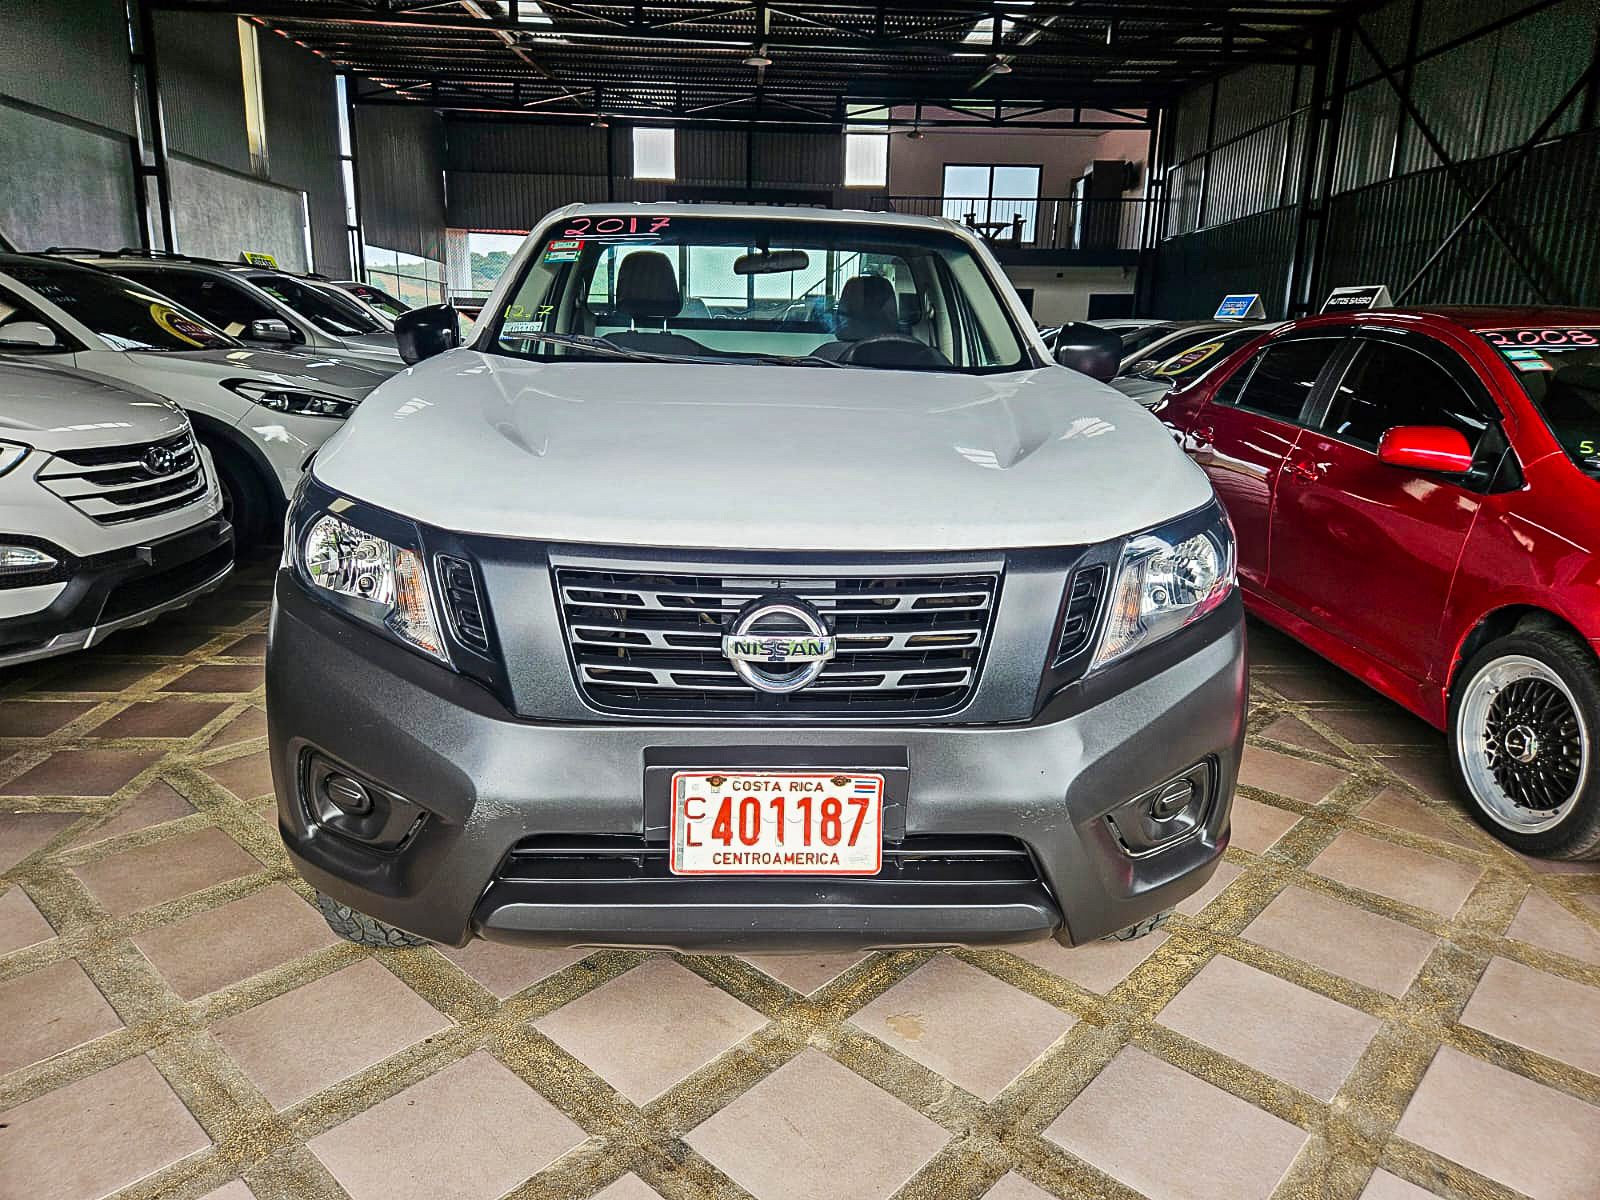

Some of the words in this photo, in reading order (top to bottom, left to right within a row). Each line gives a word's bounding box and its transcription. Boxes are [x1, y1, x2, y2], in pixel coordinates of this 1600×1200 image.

[563, 217, 671, 236] 2017
[1485, 330, 1598, 345] 2008
[734, 641, 824, 656] NISSAN
[732, 781, 782, 792] COSTA
[789, 781, 824, 792] RICA
[711, 797, 870, 847] 401187
[712, 852, 840, 865] CENTROAMERICA
